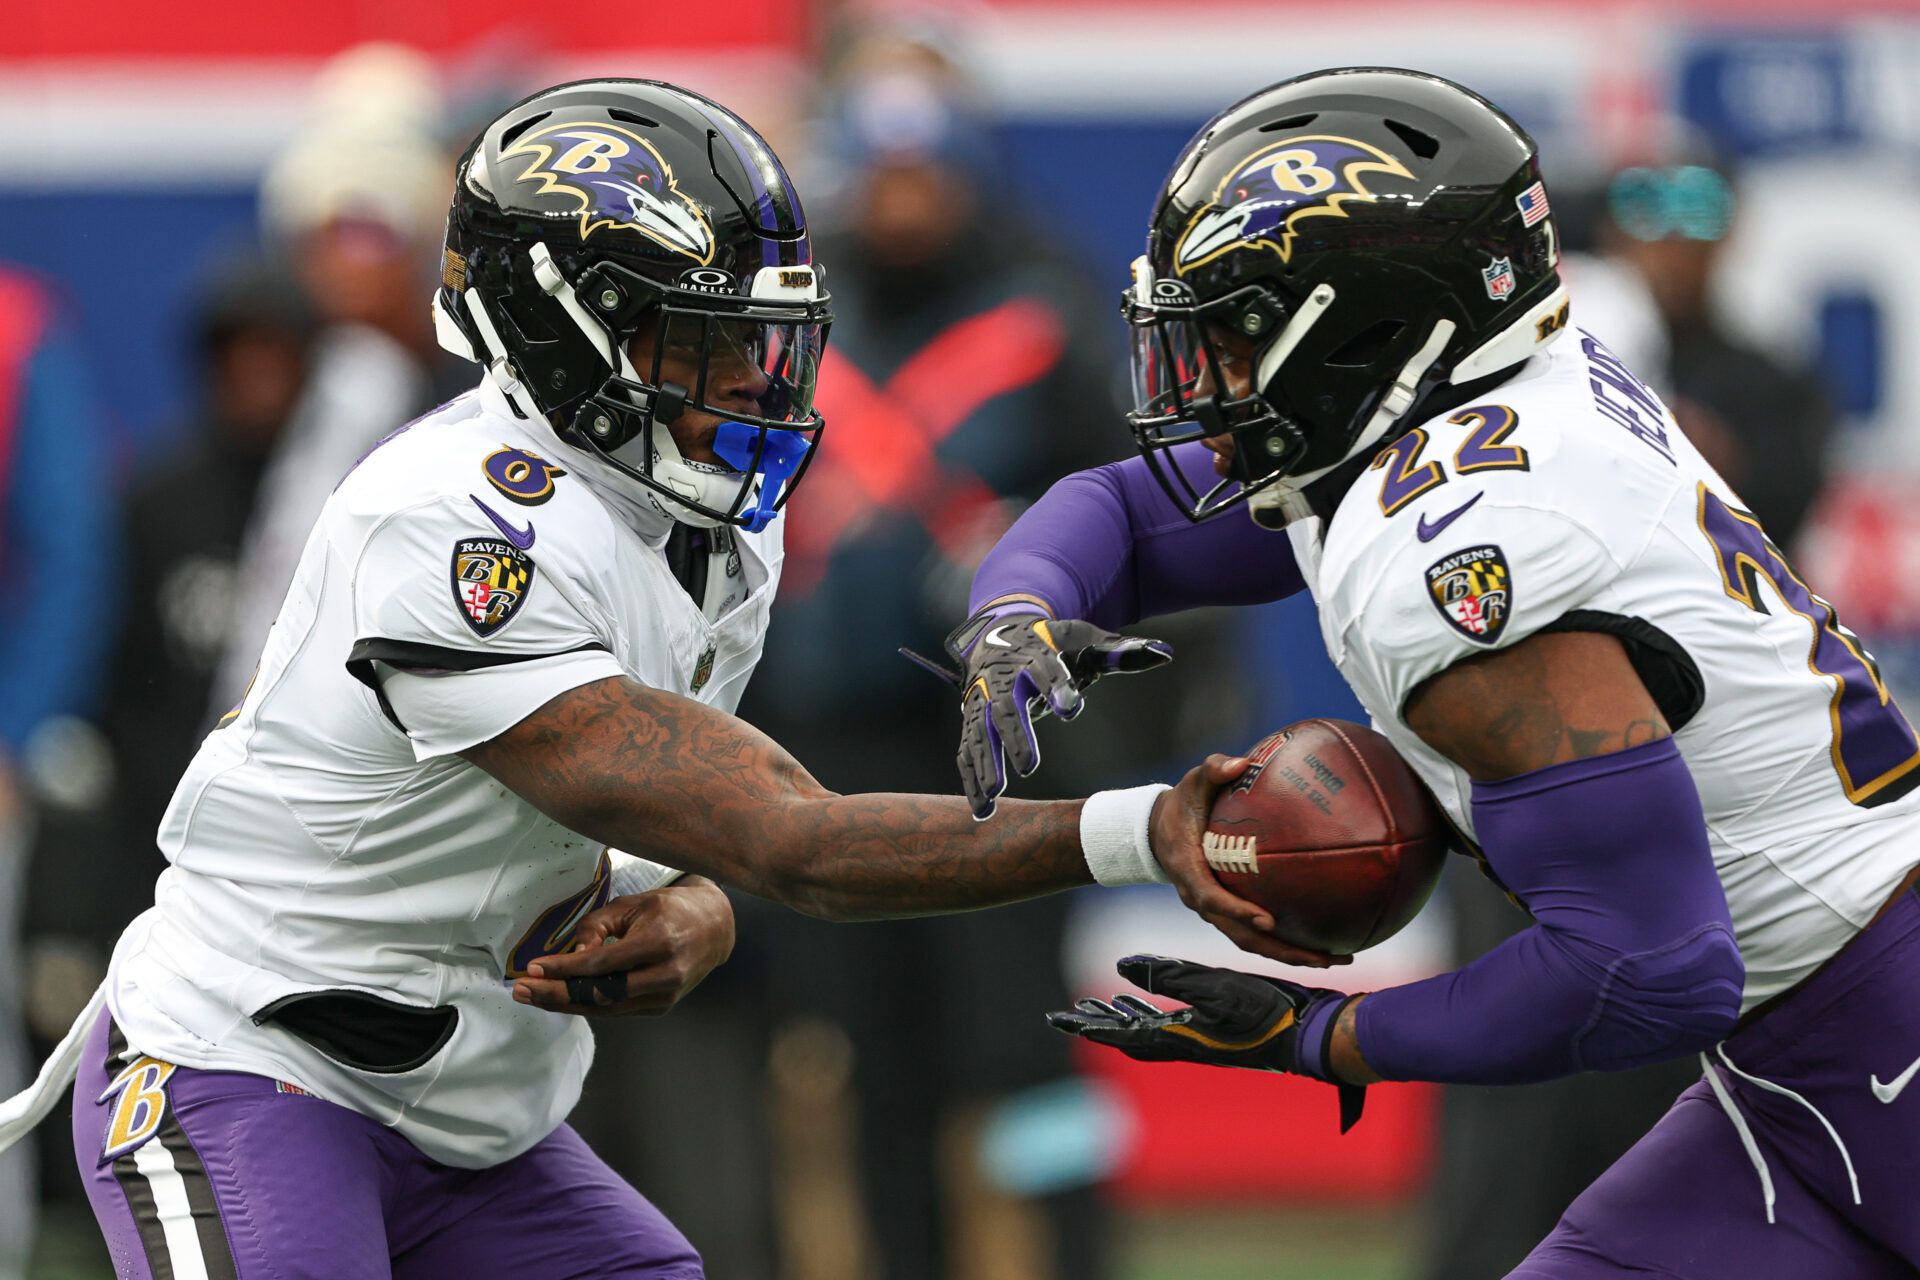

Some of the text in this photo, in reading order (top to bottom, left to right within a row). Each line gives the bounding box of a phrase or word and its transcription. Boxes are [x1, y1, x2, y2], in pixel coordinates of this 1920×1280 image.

[550, 131, 630, 175] B
[1239, 148, 1336, 196] B
[680, 282, 735, 295] OAKLEY
[779, 271, 814, 289] RAVENS
[1490, 274, 1513, 295] NFL
[1370, 404, 1531, 519] 22
[460, 542, 527, 562] RAVENS
[1428, 548, 1496, 579] RAVENS
[460, 556, 497, 582] B
[1436, 569, 1471, 604] B
[485, 590, 517, 618] R
[1477, 589, 1507, 623] R
[95, 1055, 178, 1170] B
